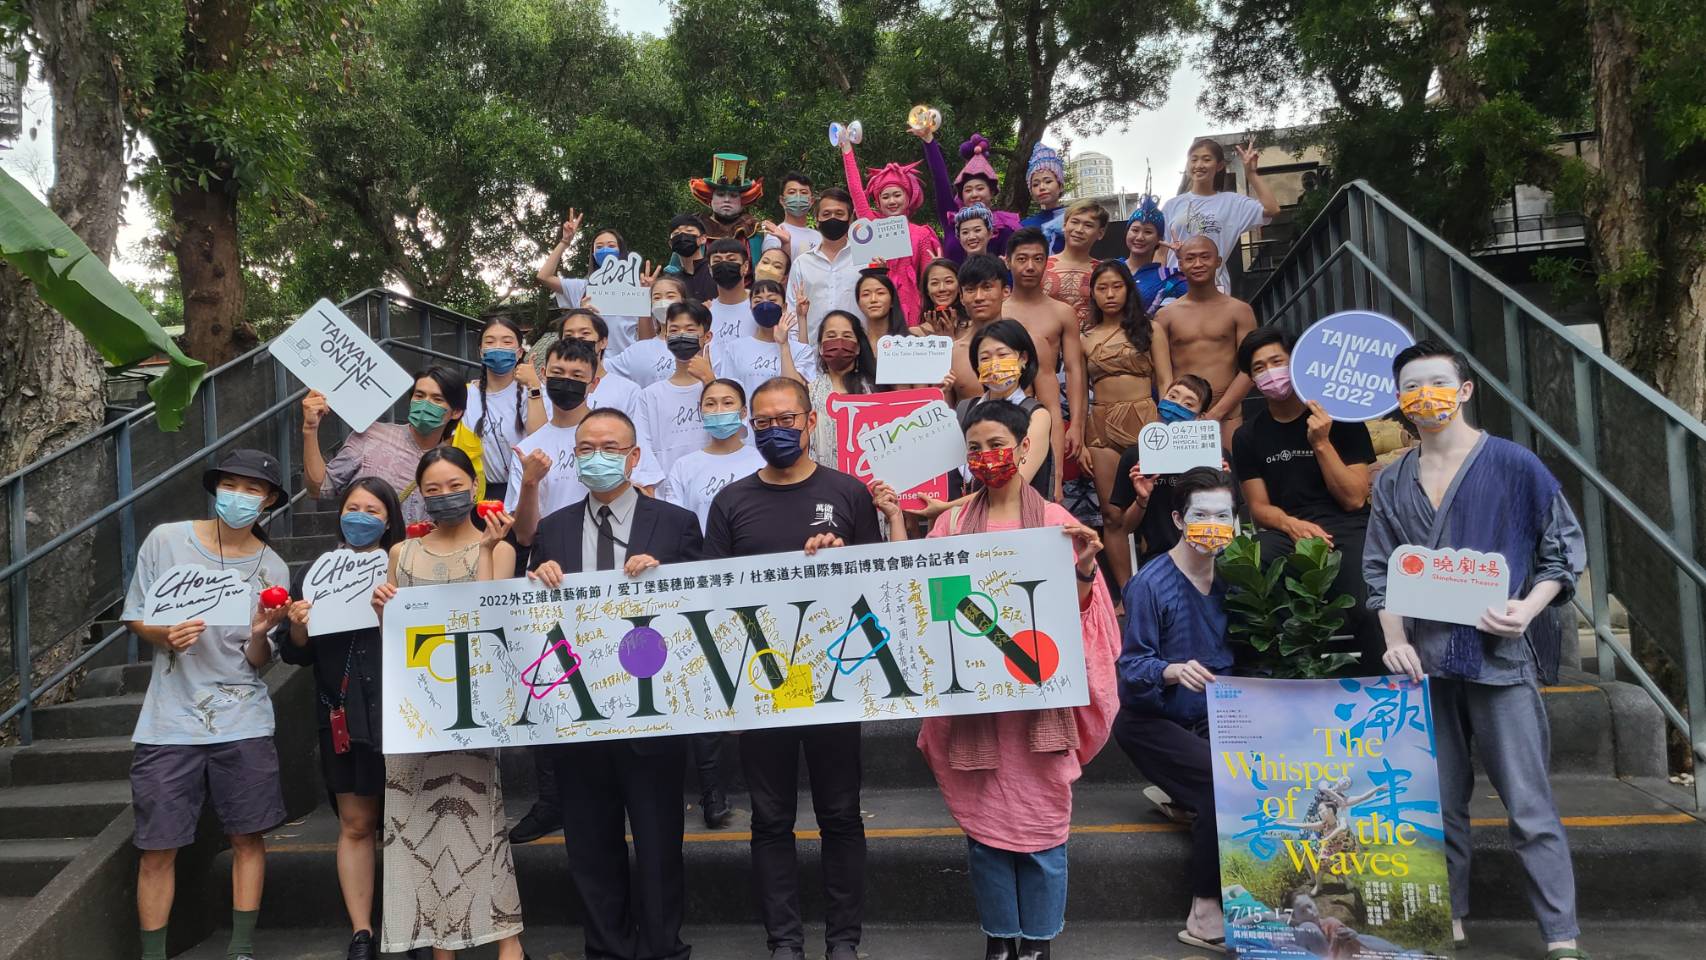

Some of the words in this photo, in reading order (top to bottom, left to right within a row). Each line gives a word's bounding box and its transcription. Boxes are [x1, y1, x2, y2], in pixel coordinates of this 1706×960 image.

[318, 310, 378, 373] TAIWAN
[1321, 328, 1397, 359] TAIWAN
[1305, 360, 1395, 394] AVIGNON
[1322, 382, 1375, 407] 2022
[1172, 425, 1198, 434] 0471
[1433, 555, 1500, 577] 曉劇場
[412, 578, 1048, 731] TAIWAN
[1313, 727, 1383, 758] The
[1222, 751, 1355, 790] Whisper
[1263, 786, 1301, 819] of
[1356, 811, 1416, 846] the
[1283, 838, 1410, 877] Waves
